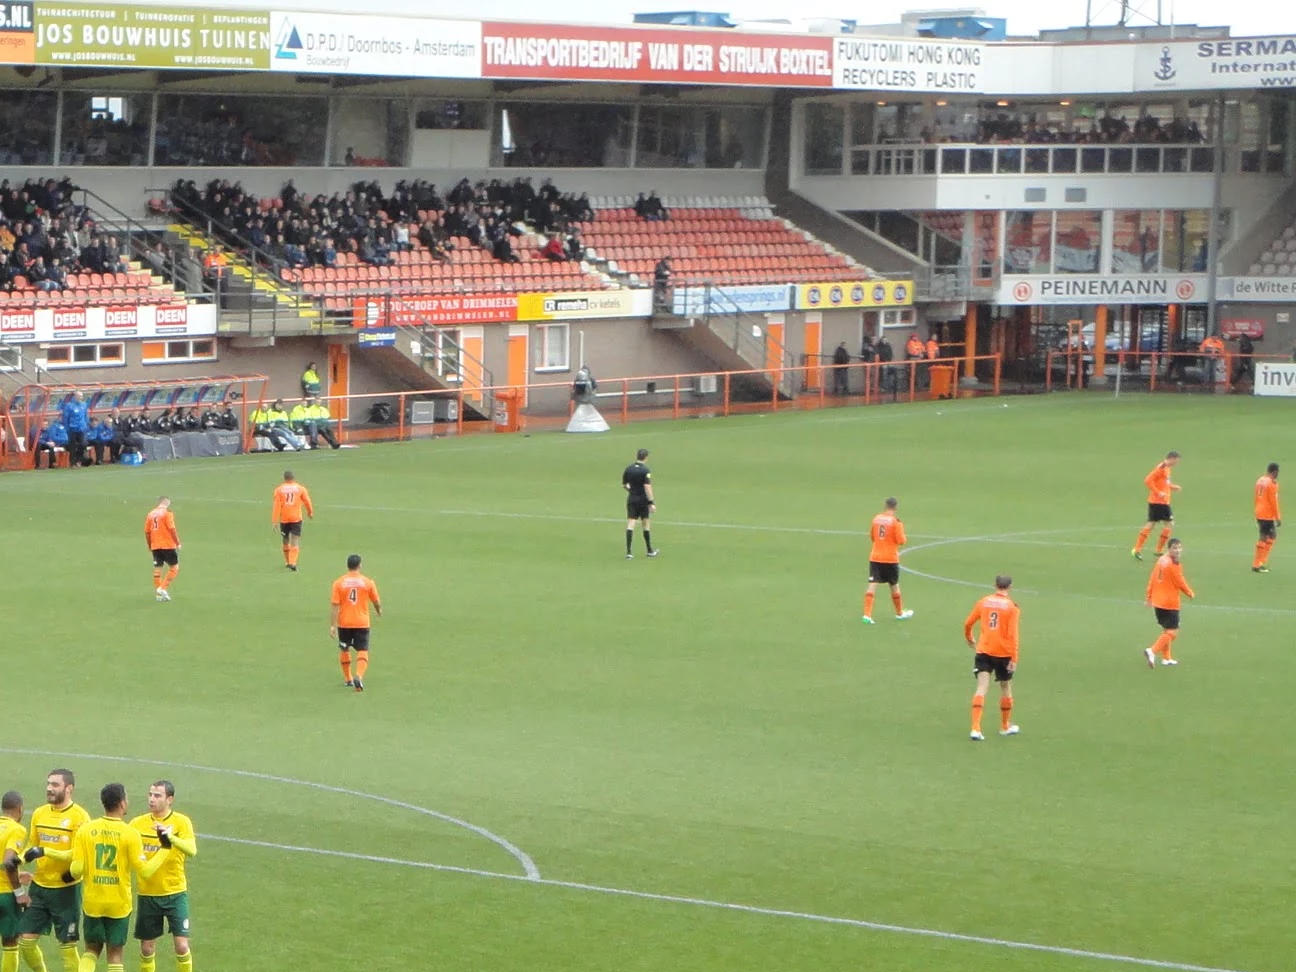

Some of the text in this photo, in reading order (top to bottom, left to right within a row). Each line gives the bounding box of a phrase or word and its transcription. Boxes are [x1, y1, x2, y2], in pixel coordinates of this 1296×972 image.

[36, 23, 270, 50] JOS BOUWHUIS TUINEN
[348, 35, 402, 53] Doornbos
[413, 39, 475, 57] Amsterdam
[838, 41, 981, 66] FUKUTOMI HONG KONG
[306, 55, 350, 69] Bouwbedrijf
[484, 36, 642, 69] TRANSPORTBEDRIJF
[648, 43, 679, 70] VAN
[683, 44, 713, 71] DER
[780, 48, 832, 76] BOXTEL
[843, 68, 976, 89] RECYCLERS PLASTIC
[1040, 280, 1167, 295] PEINEMANN
[1236, 281, 1252, 293] de
[1254, 281, 1289, 293] Witte
[441, 299, 460, 310] VAN
[463, 298, 518, 309] DRIMMELEN
[2, 314, 34, 329] DEEN
[54, 312, 84, 327] DEEN
[106, 311, 136, 325] DEEN
[157, 309, 186, 323] DEEN
[349, 588, 357, 603] 4
[989, 611, 999, 629] 3
[95, 843, 118, 872] 12
